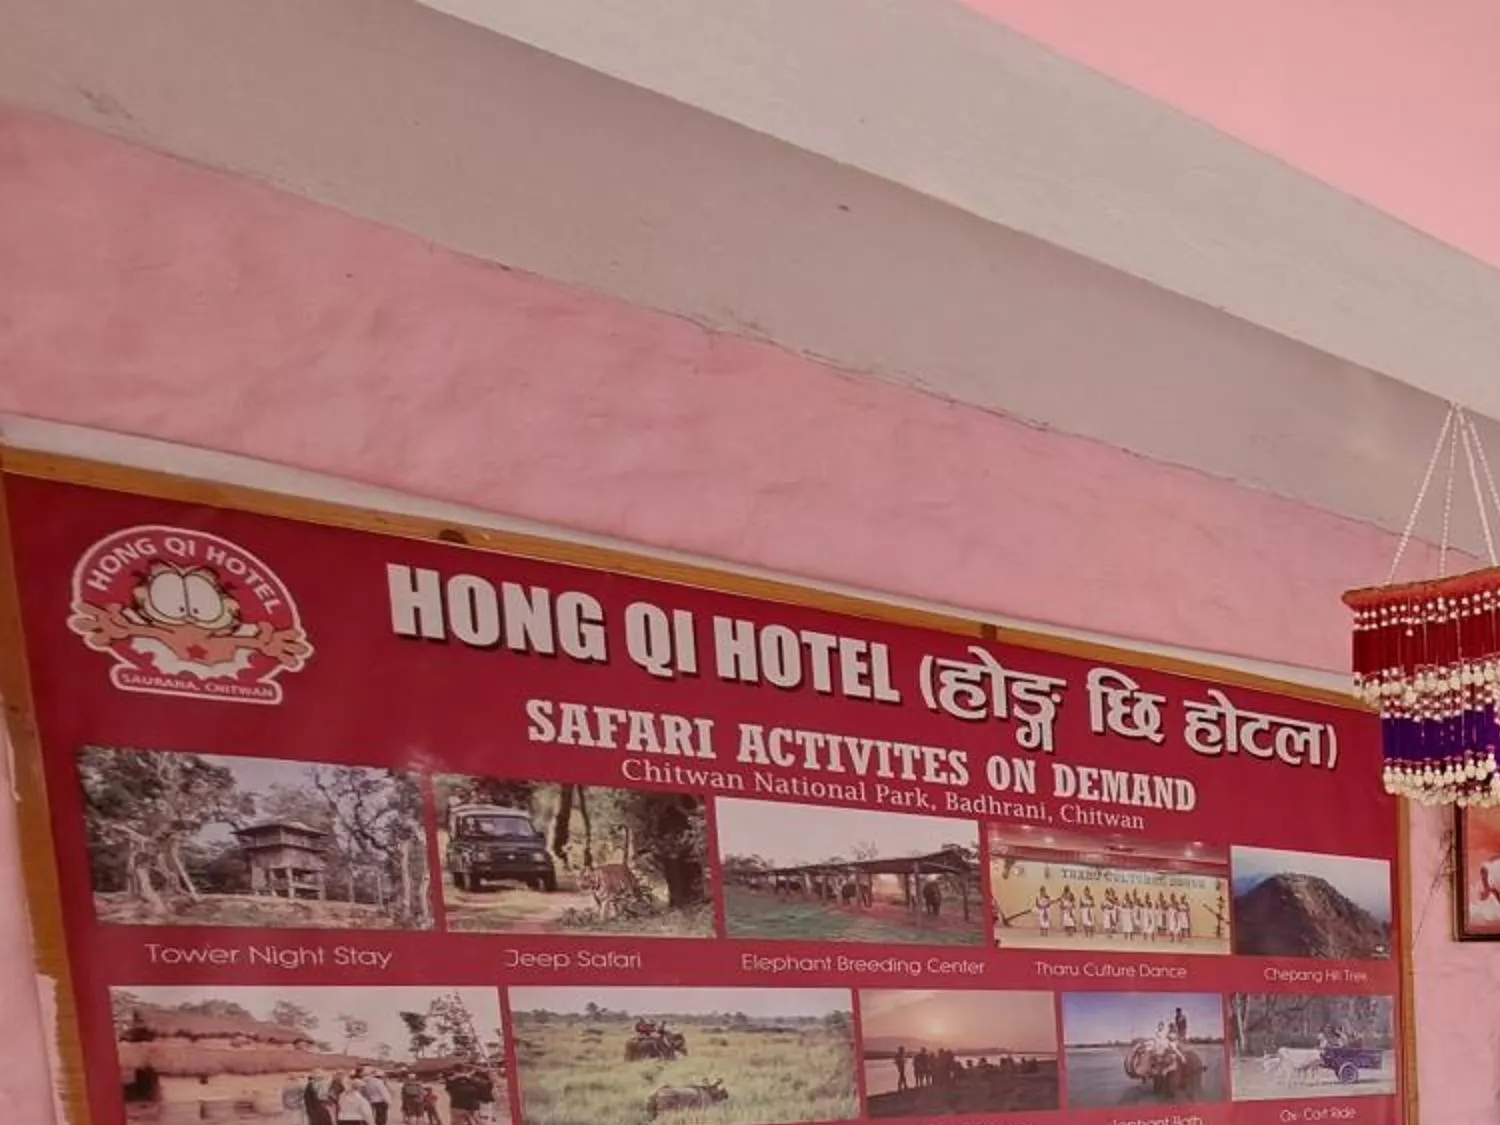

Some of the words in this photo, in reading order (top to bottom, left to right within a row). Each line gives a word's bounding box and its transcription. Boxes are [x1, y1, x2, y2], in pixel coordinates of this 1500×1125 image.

[86, 537, 157, 592] HONG
[164, 536, 195, 557] QI
[206, 546, 282, 615] HOTEL
[386, 563, 608, 663] HONG
[625, 602, 697, 678] QI
[712, 616, 900, 702] HOTEL
[527, 699, 717, 760] SAFARI
[738, 722, 969, 787] ACTIVITES
[987, 753, 1036, 797] ON
[1051, 760, 1196, 812] DEMAND
[622, 758, 747, 793] Chitwan
[753, 770, 866, 803] National
[1060, 804, 1144, 830] Chitwan
[145, 943, 240, 968] Tower
[249, 944, 324, 971] Night
[333, 946, 393, 972] Stay
[505, 949, 569, 974] Jeep
[577, 949, 642, 970] Safari
[741, 954, 831, 974] Elephant
[837, 955, 921, 977] Breeding
[927, 958, 986, 975] Center
[1035, 961, 1078, 977] Tharu
[1139, 964, 1187, 979] Dance
[1263, 967, 1322, 984] Chepang
